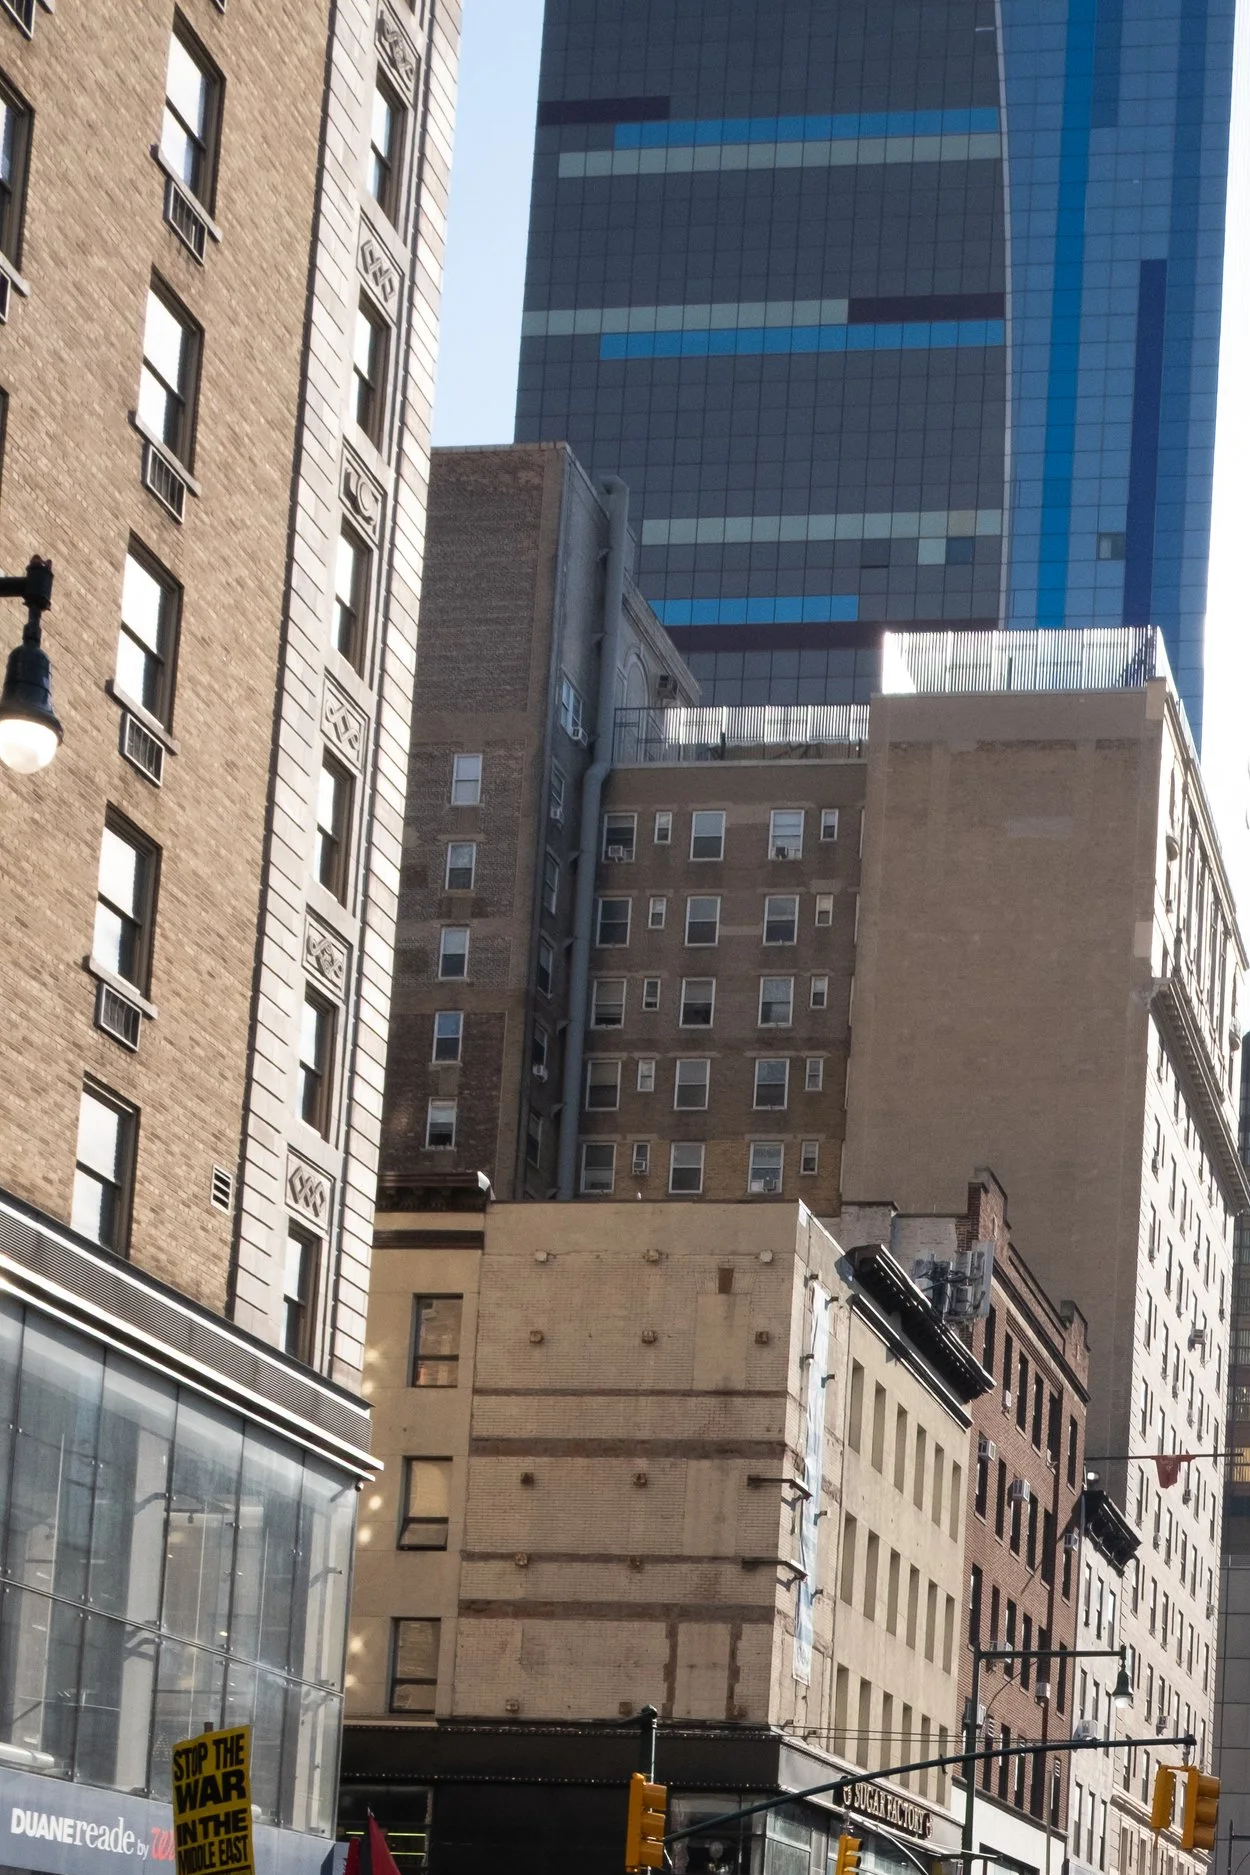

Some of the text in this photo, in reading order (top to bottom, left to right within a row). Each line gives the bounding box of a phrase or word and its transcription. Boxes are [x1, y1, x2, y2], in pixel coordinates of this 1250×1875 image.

[174, 1733, 245, 1782] STOP THE
[175, 1768, 247, 1815] WAR
[854, 1783, 926, 1836] SUGAR FACTORY
[137, 1839, 149, 1860] by
[177, 1819, 197, 1848] IN
[199, 1809, 248, 1841] THE
[219, 1836, 249, 1867] EAST
